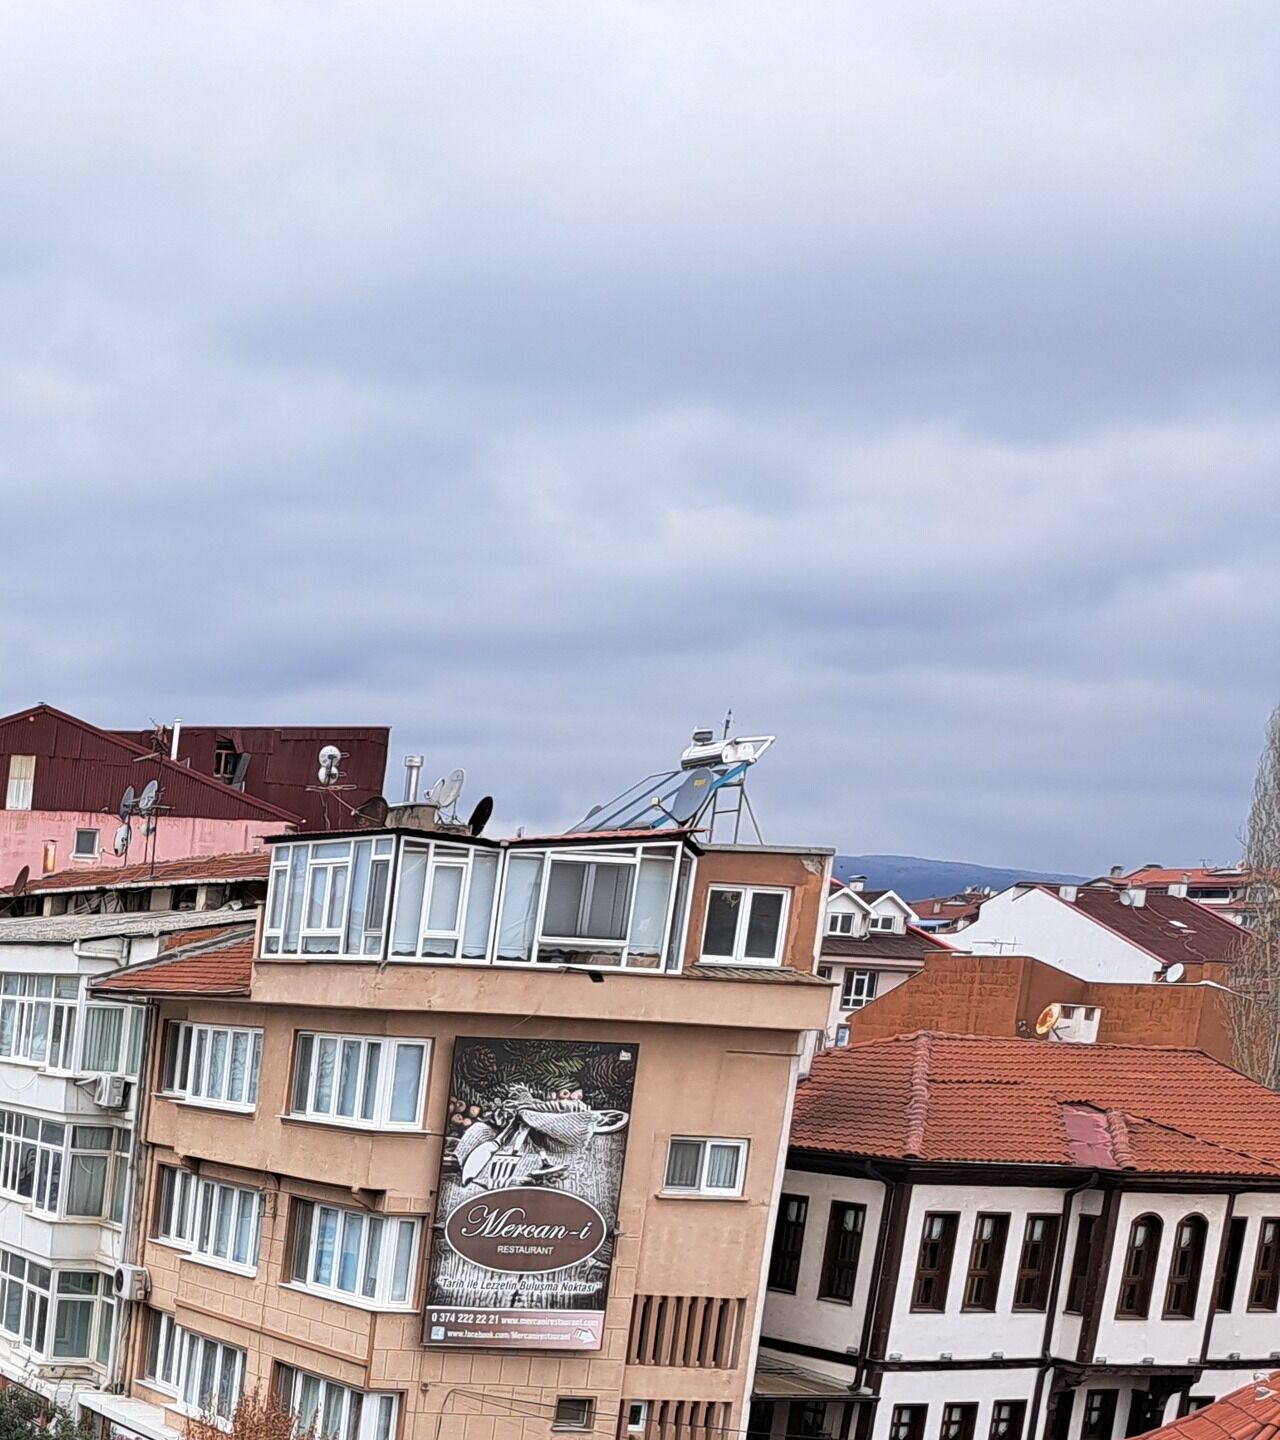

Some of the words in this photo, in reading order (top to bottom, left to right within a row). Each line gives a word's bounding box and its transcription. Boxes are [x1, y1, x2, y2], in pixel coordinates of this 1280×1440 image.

[460, 1204, 593, 1241] Mercan-i
[497, 1245, 554, 1256] RESTAURANT
[467, 1279, 478, 1290] ile
[481, 1280, 518, 1291] Lezzetin
[519, 1281, 559, 1293] Buluşma
[431, 1313, 438, 1323] 0
[440, 1313, 456, 1323] 374
[458, 1314, 474, 1324] 222
[476, 1314, 487, 1325] 22
[489, 1314, 499, 1325] 21
